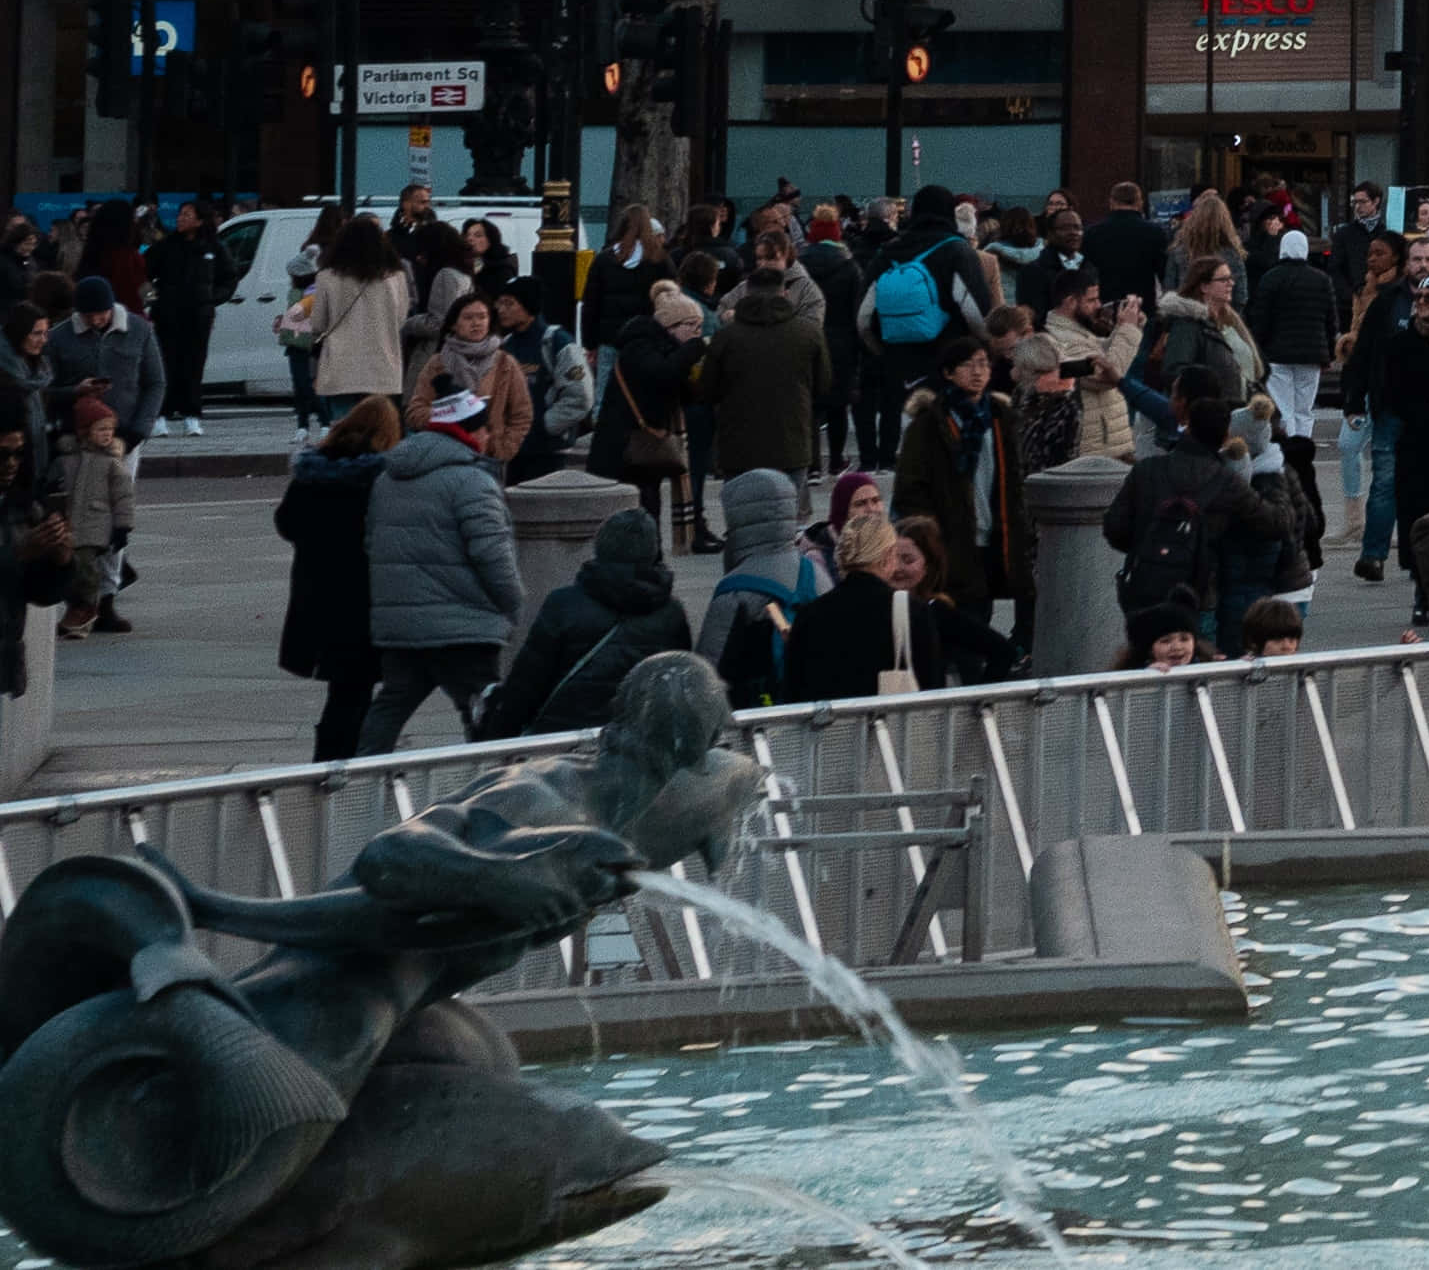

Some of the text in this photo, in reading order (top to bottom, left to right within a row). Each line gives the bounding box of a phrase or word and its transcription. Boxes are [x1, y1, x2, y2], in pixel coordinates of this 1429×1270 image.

[1195, 28, 1307, 58] express
[362, 67, 479, 83] Parliament Sq
[363, 91, 426, 105] Victoria
[1262, 134, 1316, 154] Tobacco
